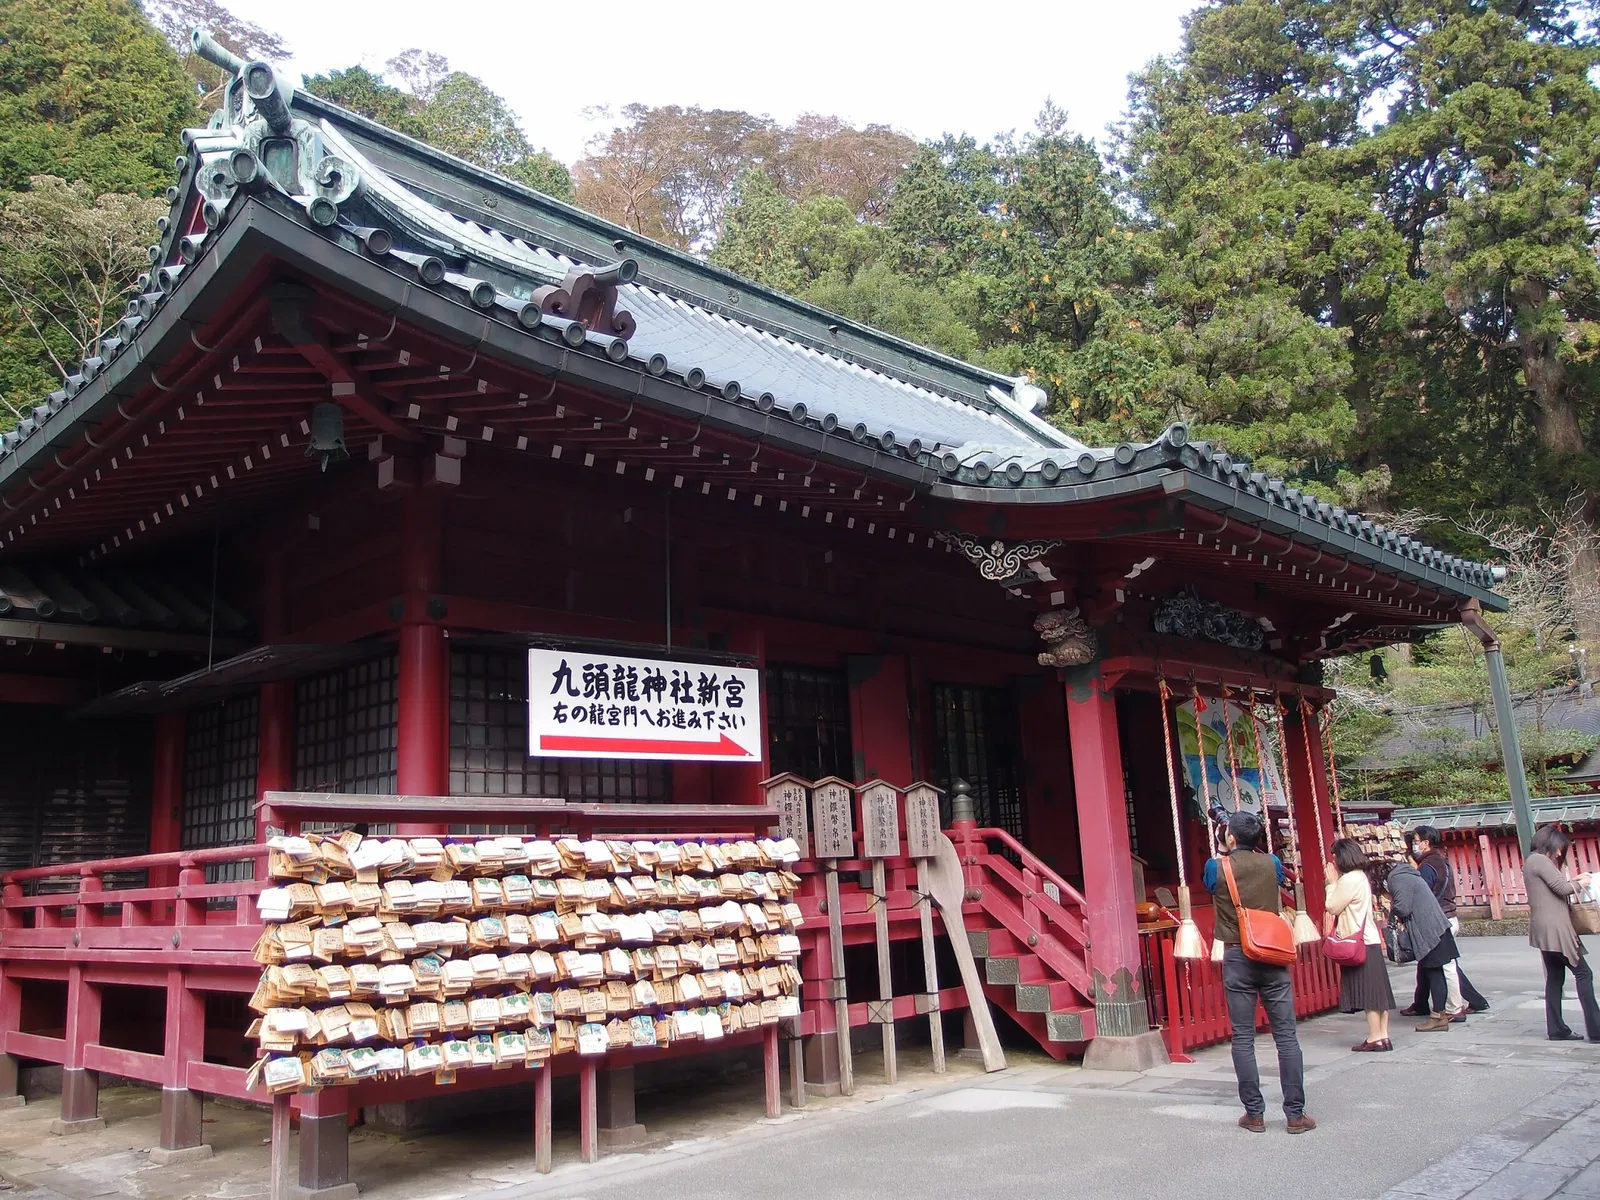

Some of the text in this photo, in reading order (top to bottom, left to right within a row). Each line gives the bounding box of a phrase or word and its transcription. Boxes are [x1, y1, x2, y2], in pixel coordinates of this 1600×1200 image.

[550, 658, 746, 708] 九頭龍神社新宮
[552, 701, 746, 731] 右の龍宮門へお進み下さい
